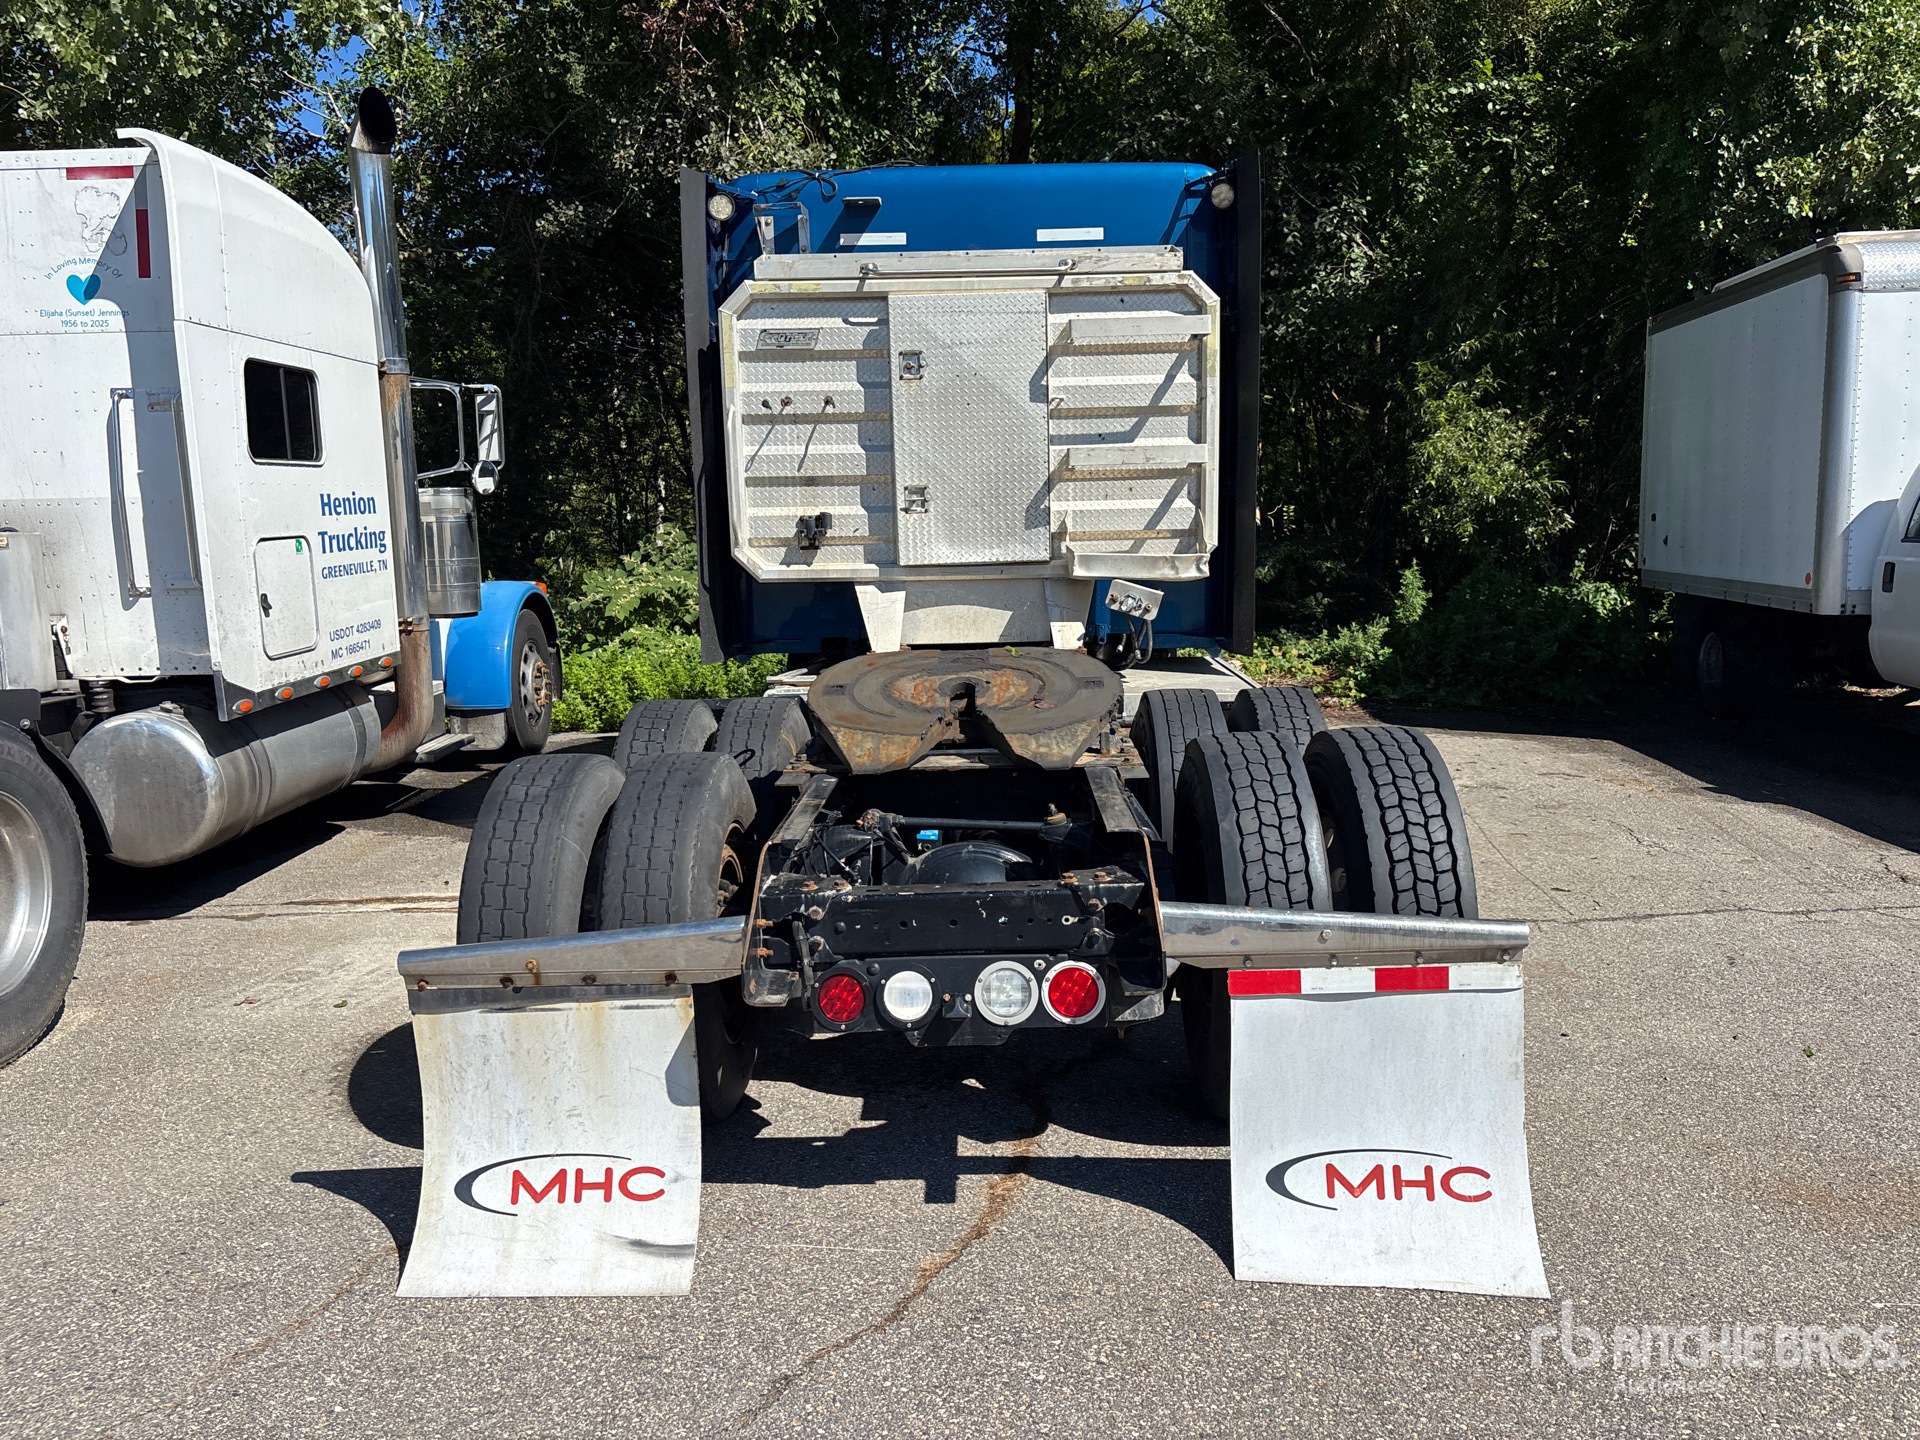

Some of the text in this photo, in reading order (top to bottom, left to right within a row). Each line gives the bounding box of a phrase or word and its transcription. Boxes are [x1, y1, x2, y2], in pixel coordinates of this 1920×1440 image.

[44, 257, 123, 280] In Loving Memory Of
[40, 308, 130, 319] Elijaha (Sunset) Jennings
[60, 320, 78, 328] 1956
[90, 320, 110, 328] 2025
[319, 490, 377, 517] Henion
[317, 525, 387, 554] Trucking
[321, 559, 388, 579] GREENEVILLE, TN
[329, 625, 354, 642] USDOT
[331, 646, 344, 660] MC
[510, 1165, 666, 1206] MHC
[1325, 1162, 1493, 1203] MHC
